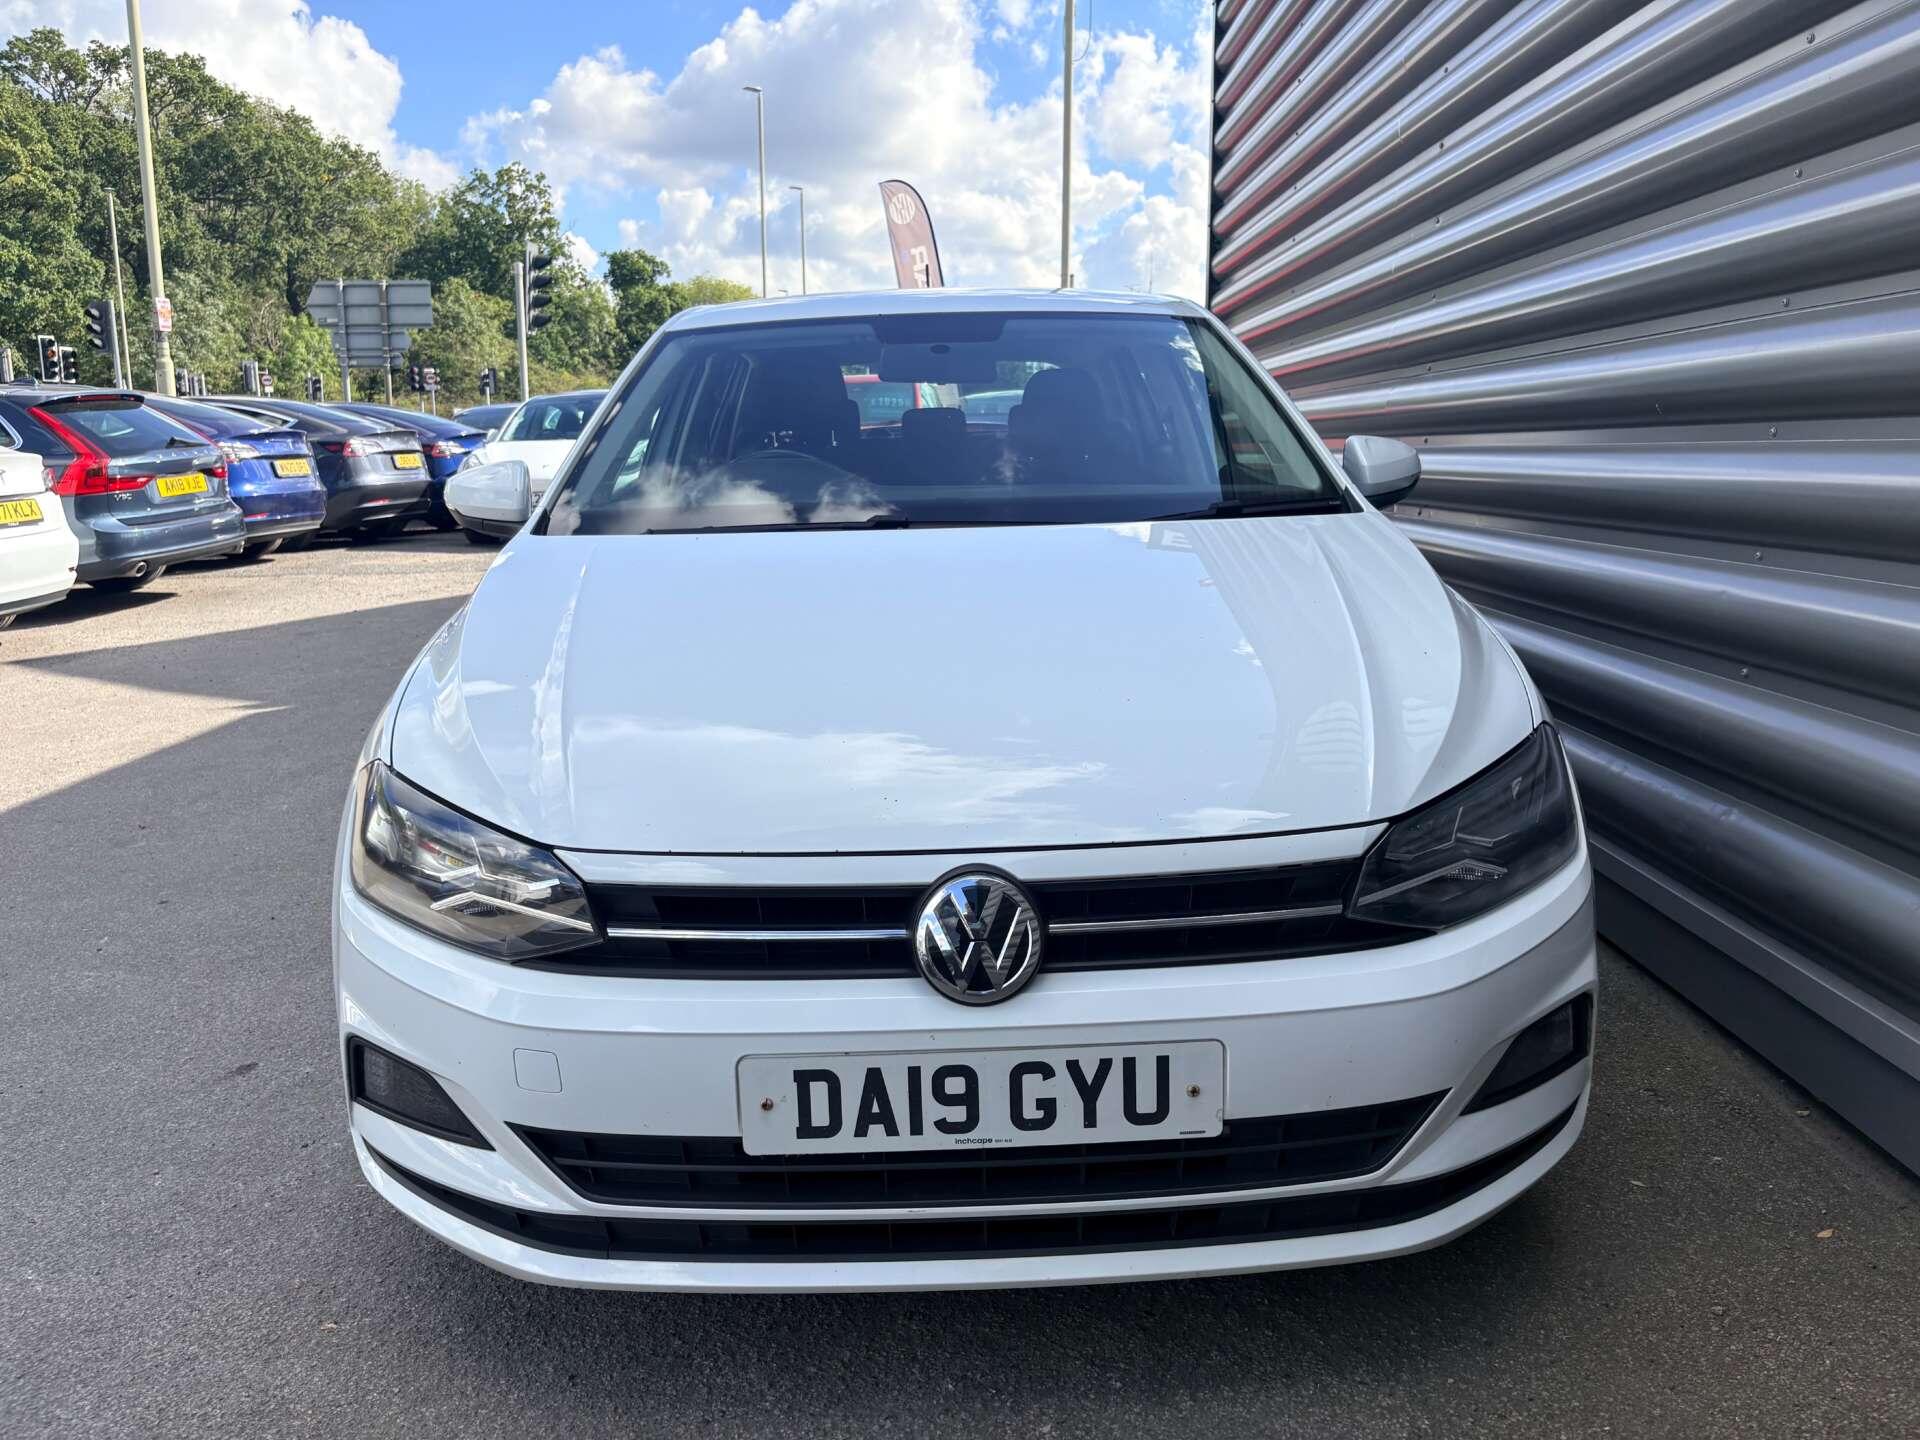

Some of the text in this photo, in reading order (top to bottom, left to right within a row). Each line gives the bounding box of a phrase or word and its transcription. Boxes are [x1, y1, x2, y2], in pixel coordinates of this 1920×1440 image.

[0, 500, 37, 520] 71KLX
[793, 1055, 1171, 1139] DA19 GYU
